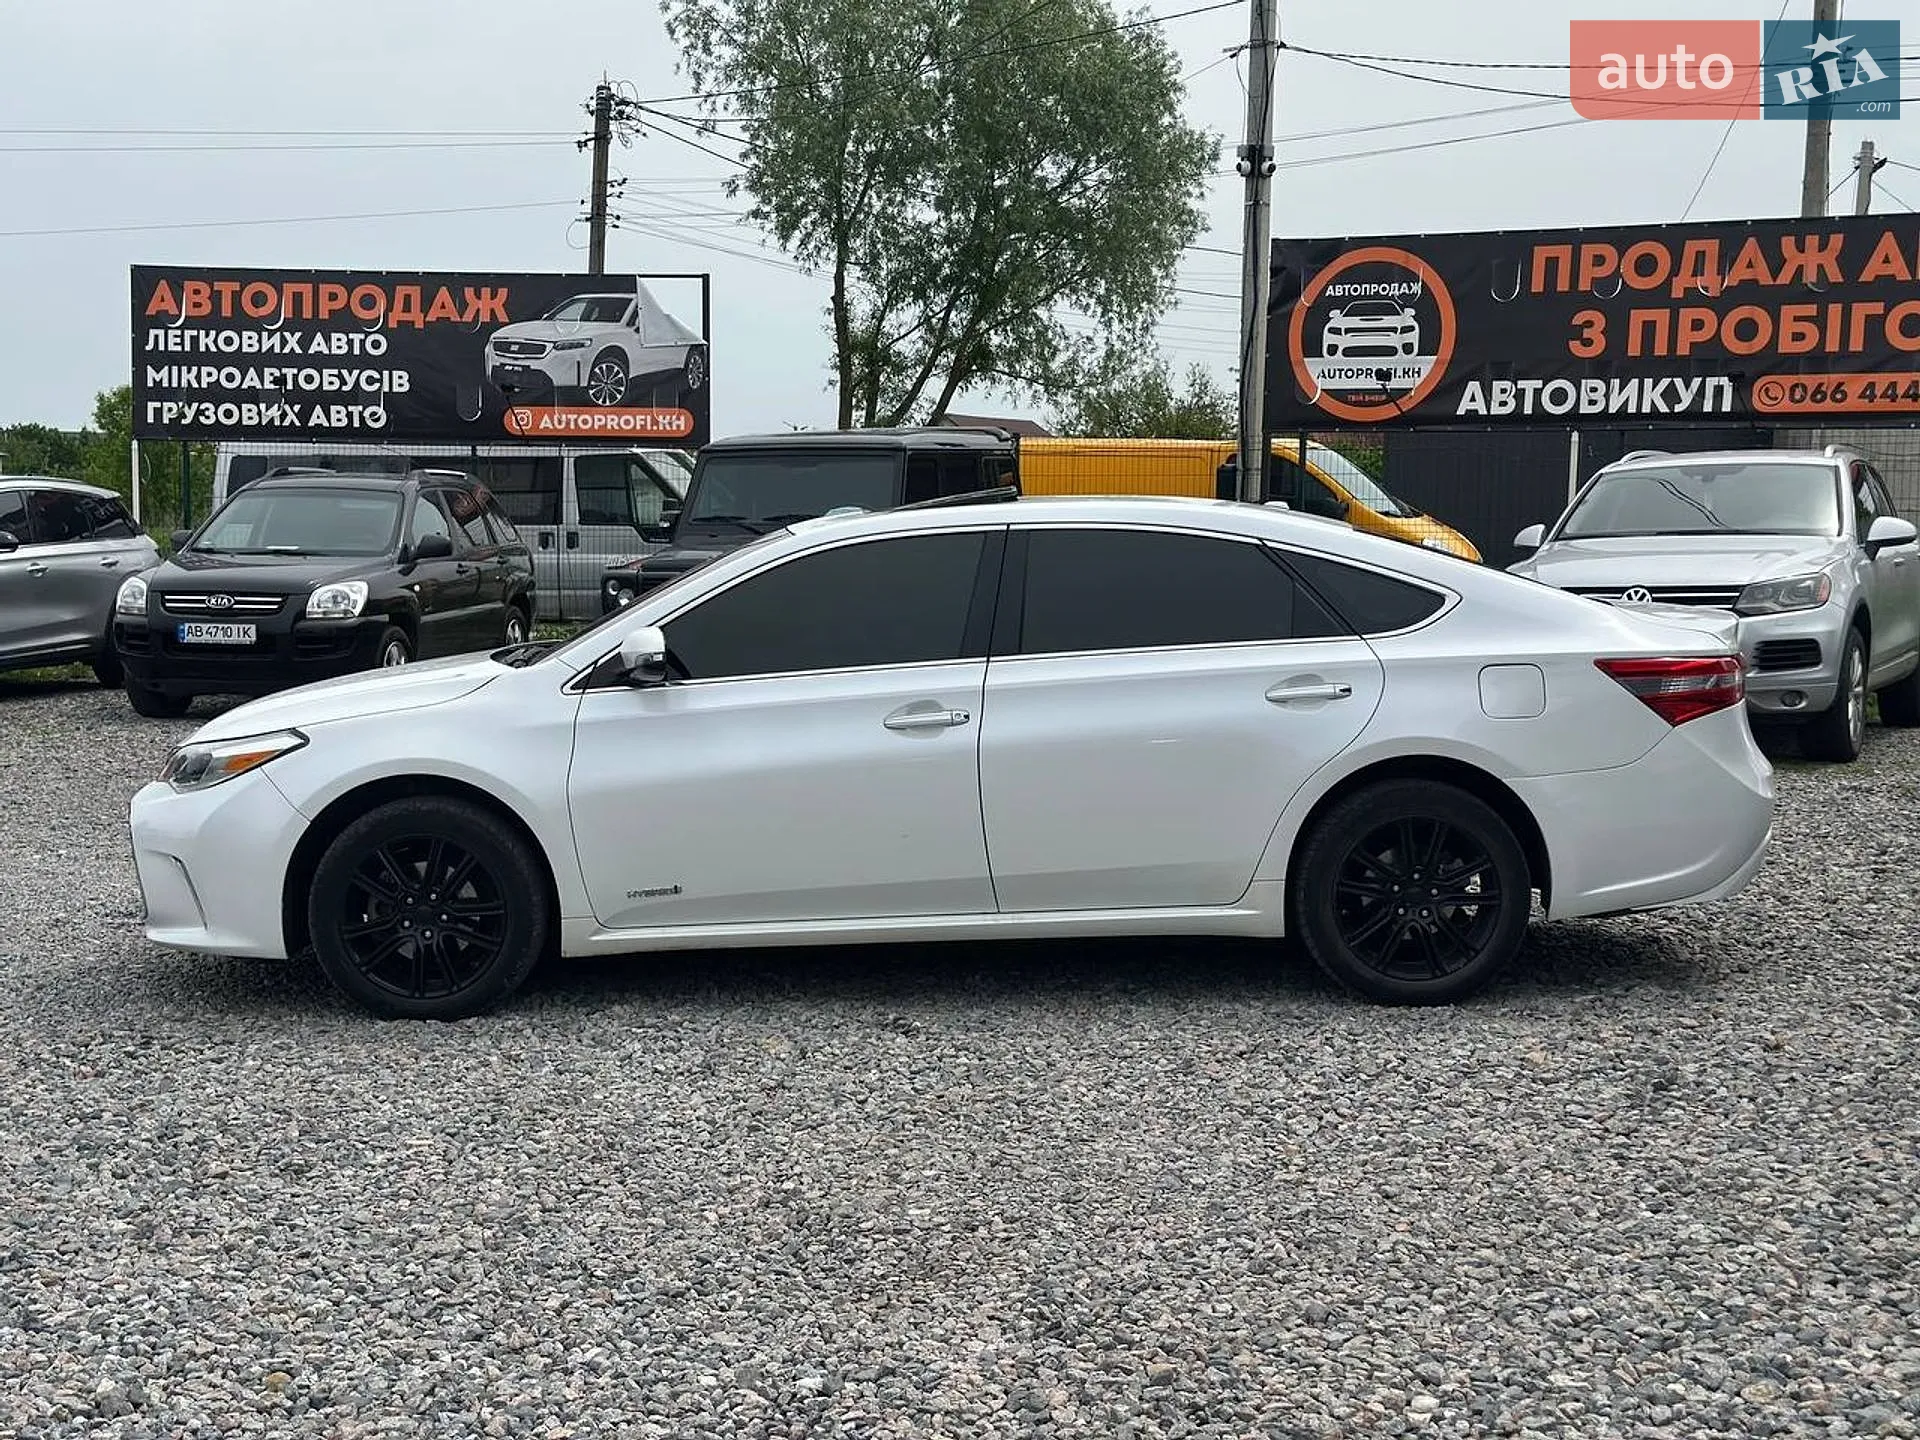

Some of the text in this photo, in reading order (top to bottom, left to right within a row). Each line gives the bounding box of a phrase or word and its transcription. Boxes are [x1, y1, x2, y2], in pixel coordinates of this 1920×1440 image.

[1531, 229, 1920, 298] ПРОДАЖ А
[1325, 282, 1422, 298] АВТОПРОДАЖ
[145, 279, 510, 329] АВТОПРОДАЖ
[145, 328, 388, 357] ЛЕГКОВИХ АВТО
[1456, 375, 1734, 416] АВТОВИКУП
[1788, 381, 1848, 404] 066
[146, 401, 387, 429] ГРУЗОВИХ АВТО
[539, 413, 685, 431] AUTOPROFI.KH
[209, 598, 230, 606] KIA
[186, 625, 252, 639] AB 4710 IK
